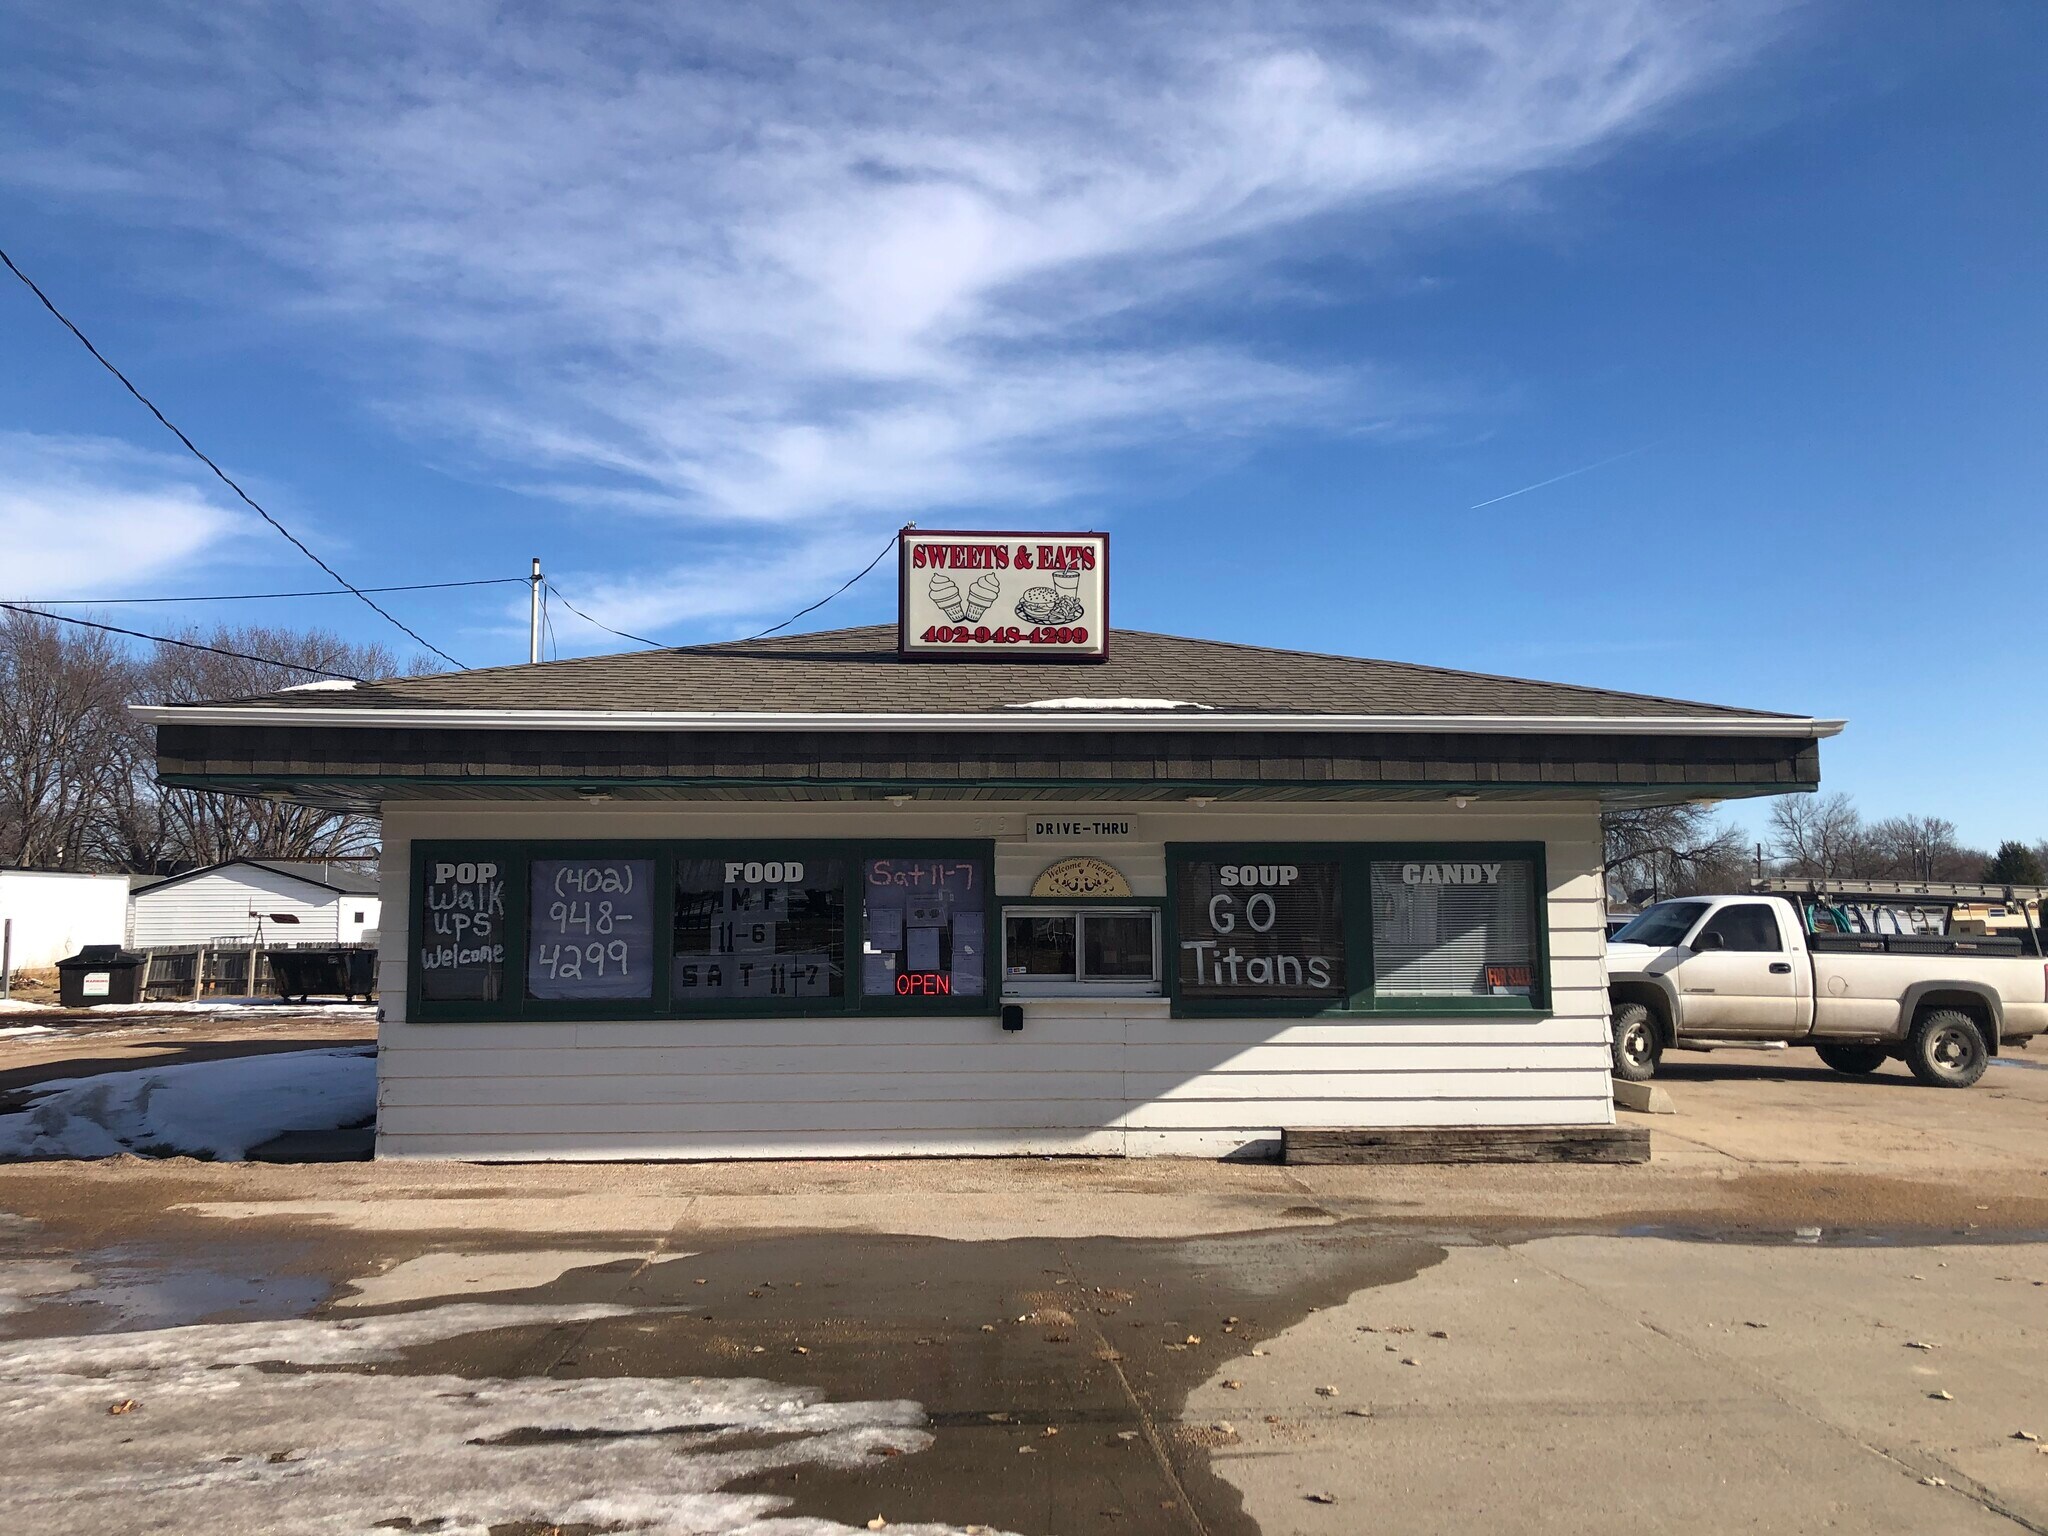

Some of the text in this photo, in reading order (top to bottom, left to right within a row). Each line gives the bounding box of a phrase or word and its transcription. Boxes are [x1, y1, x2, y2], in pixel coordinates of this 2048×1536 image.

[913, 544, 1096, 571] SWEETS & EATS
[920, 626, 1089, 645] 402-948-4299
[1036, 822, 1129, 835] DRIVE-THRU
[435, 863, 498, 884] POP
[724, 862, 804, 883] FOOD
[869, 860, 973, 891] Sat 11-7
[1046, 860, 1115, 880] Welcome Friends
[1220, 865, 1299, 886] SOUP
[1402, 863, 1502, 884] CANDY
[554, 864, 633, 898] (402)
[550, 901, 633, 935] 948-
[718, 921, 766, 953] 11-6
[539, 940, 628, 980] 4299
[1180, 940, 1331, 988] Titans
[897, 974, 950, 995] OPEN
[1487, 967, 1506, 986] FOR
